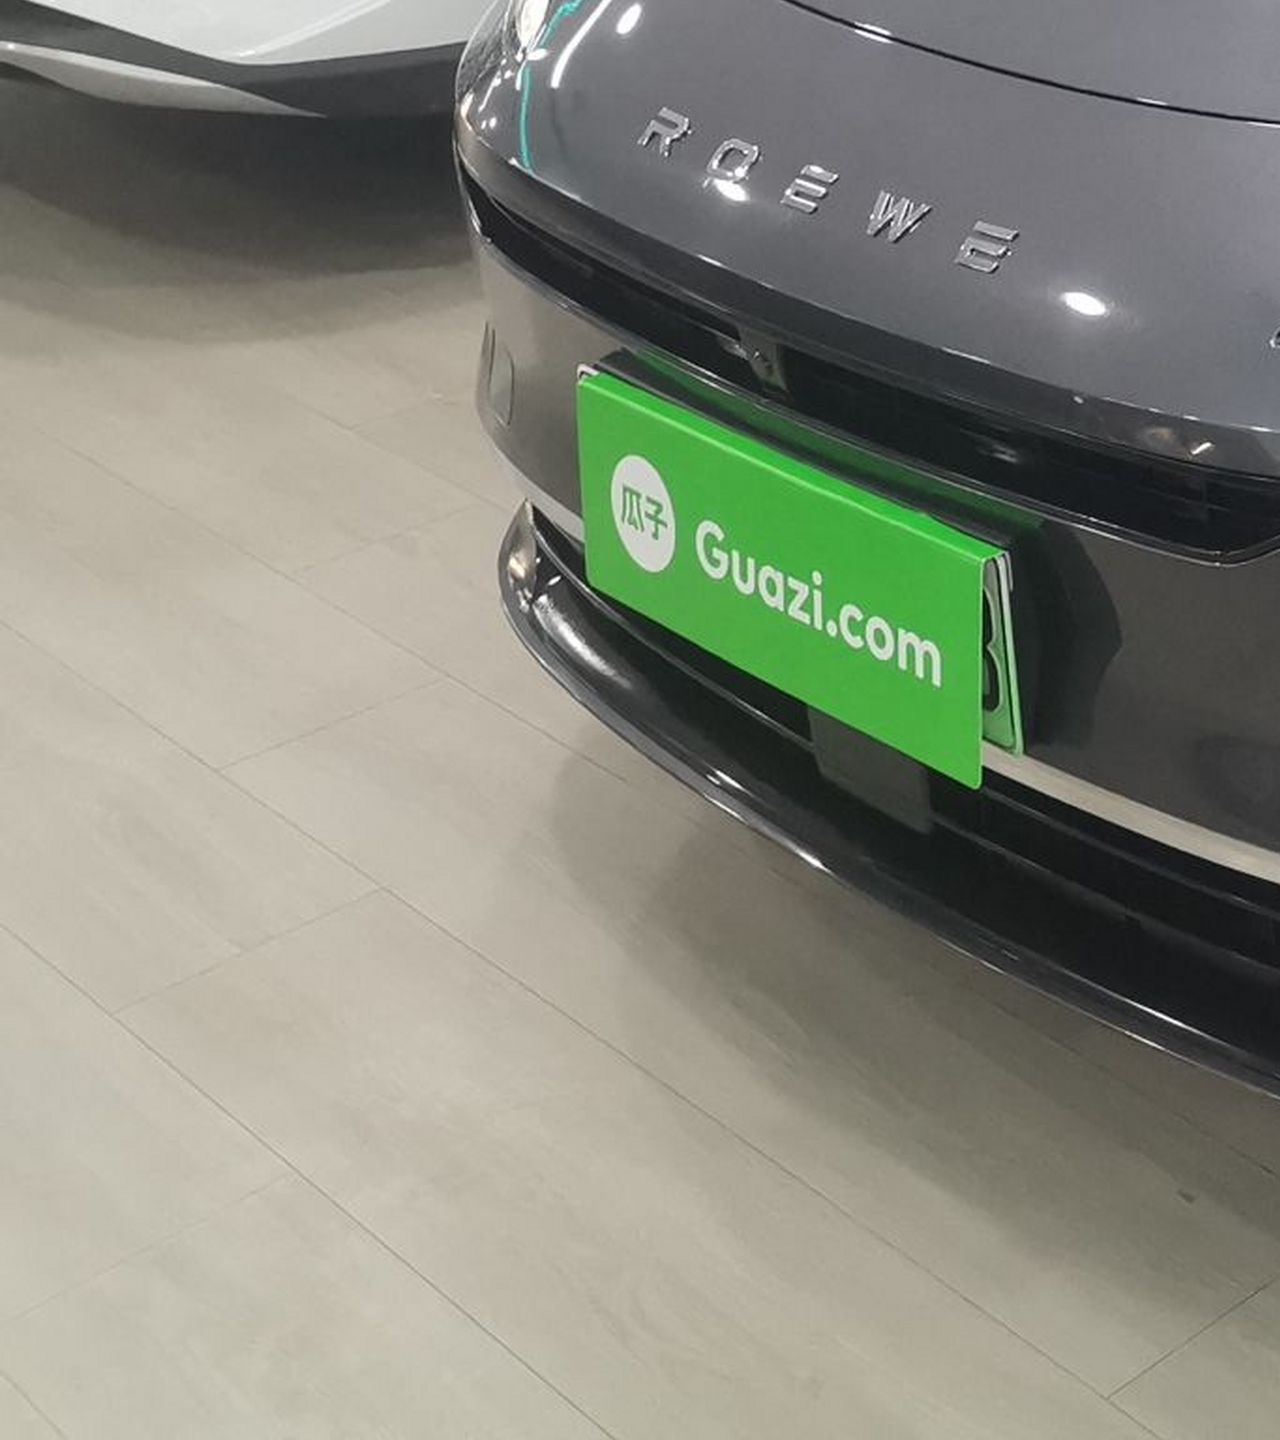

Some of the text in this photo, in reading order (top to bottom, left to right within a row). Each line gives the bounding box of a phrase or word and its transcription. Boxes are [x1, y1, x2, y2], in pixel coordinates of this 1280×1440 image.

[637, 107, 1020, 274] ROEWE
[621, 483, 668, 541] 瓜子
[695, 520, 942, 688] Guazi.com
